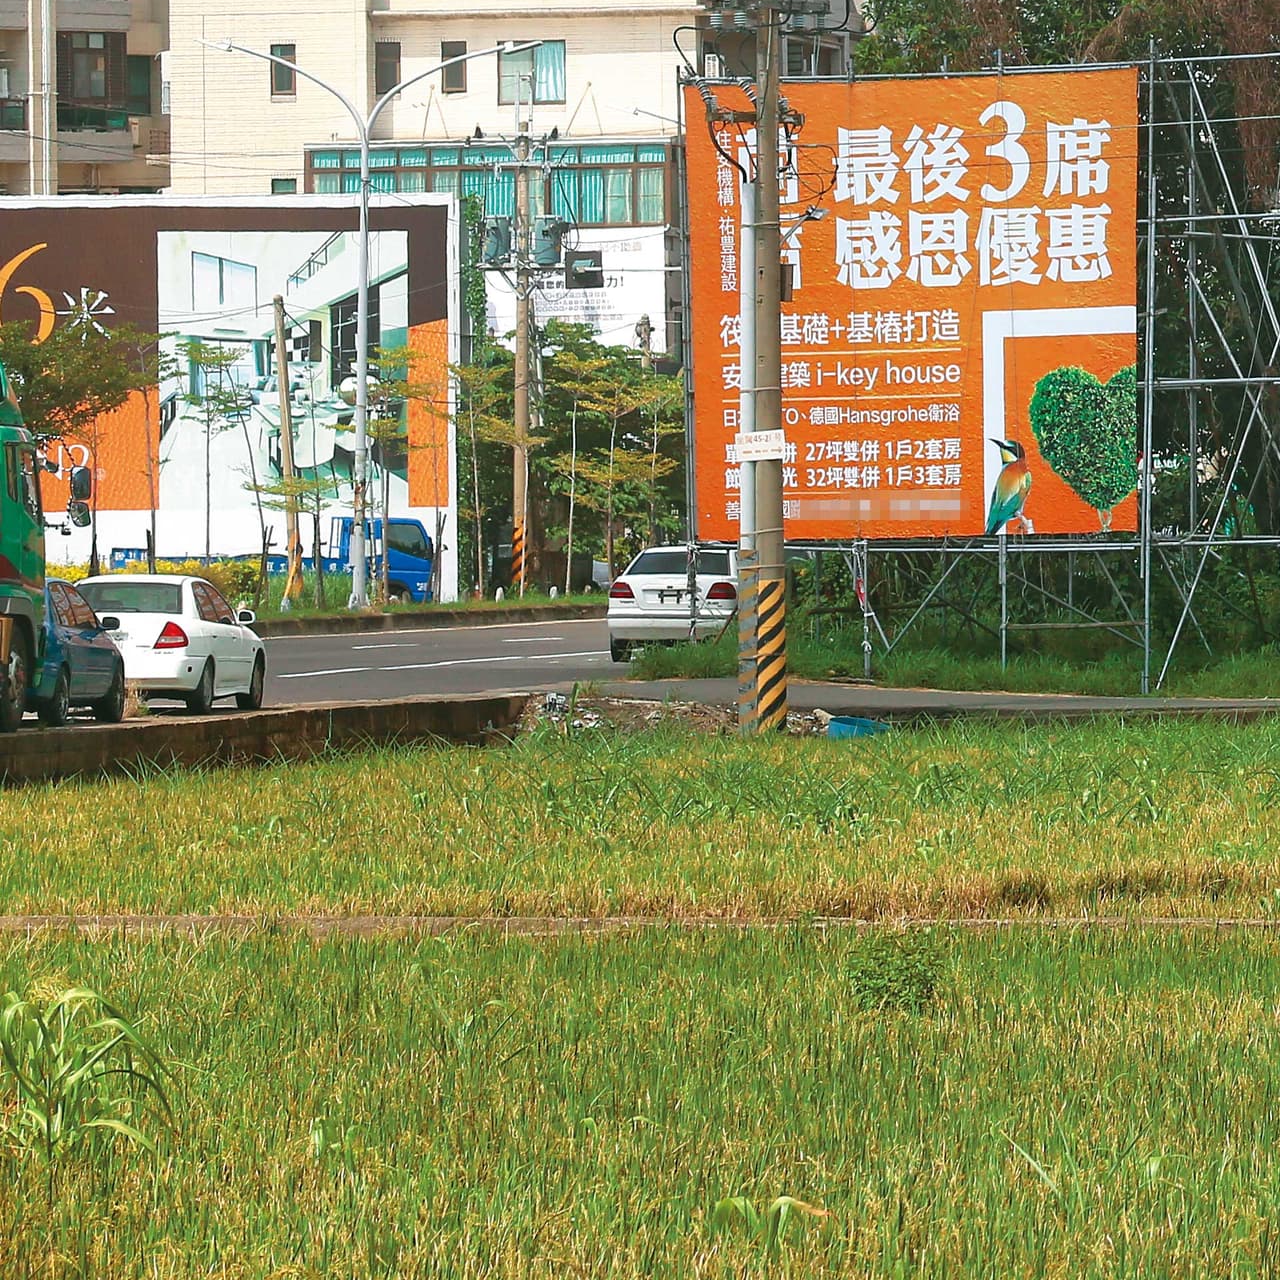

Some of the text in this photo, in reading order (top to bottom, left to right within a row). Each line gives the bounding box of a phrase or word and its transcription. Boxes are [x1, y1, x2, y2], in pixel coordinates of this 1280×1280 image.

[832, 101, 1112, 204] 最後3席
[836, 203, 1113, 288] 感恩優惠
[720, 308, 961, 348] 筏基礎+基樁打造
[817, 365, 879, 391] i-key
[886, 360, 961, 386] house
[806, 440, 880, 462] 27坪雙併
[885, 438, 961, 460] 1戶2套房
[806, 467, 880, 488] 32坪雙併
[885, 464, 962, 486] 1戶3套房
